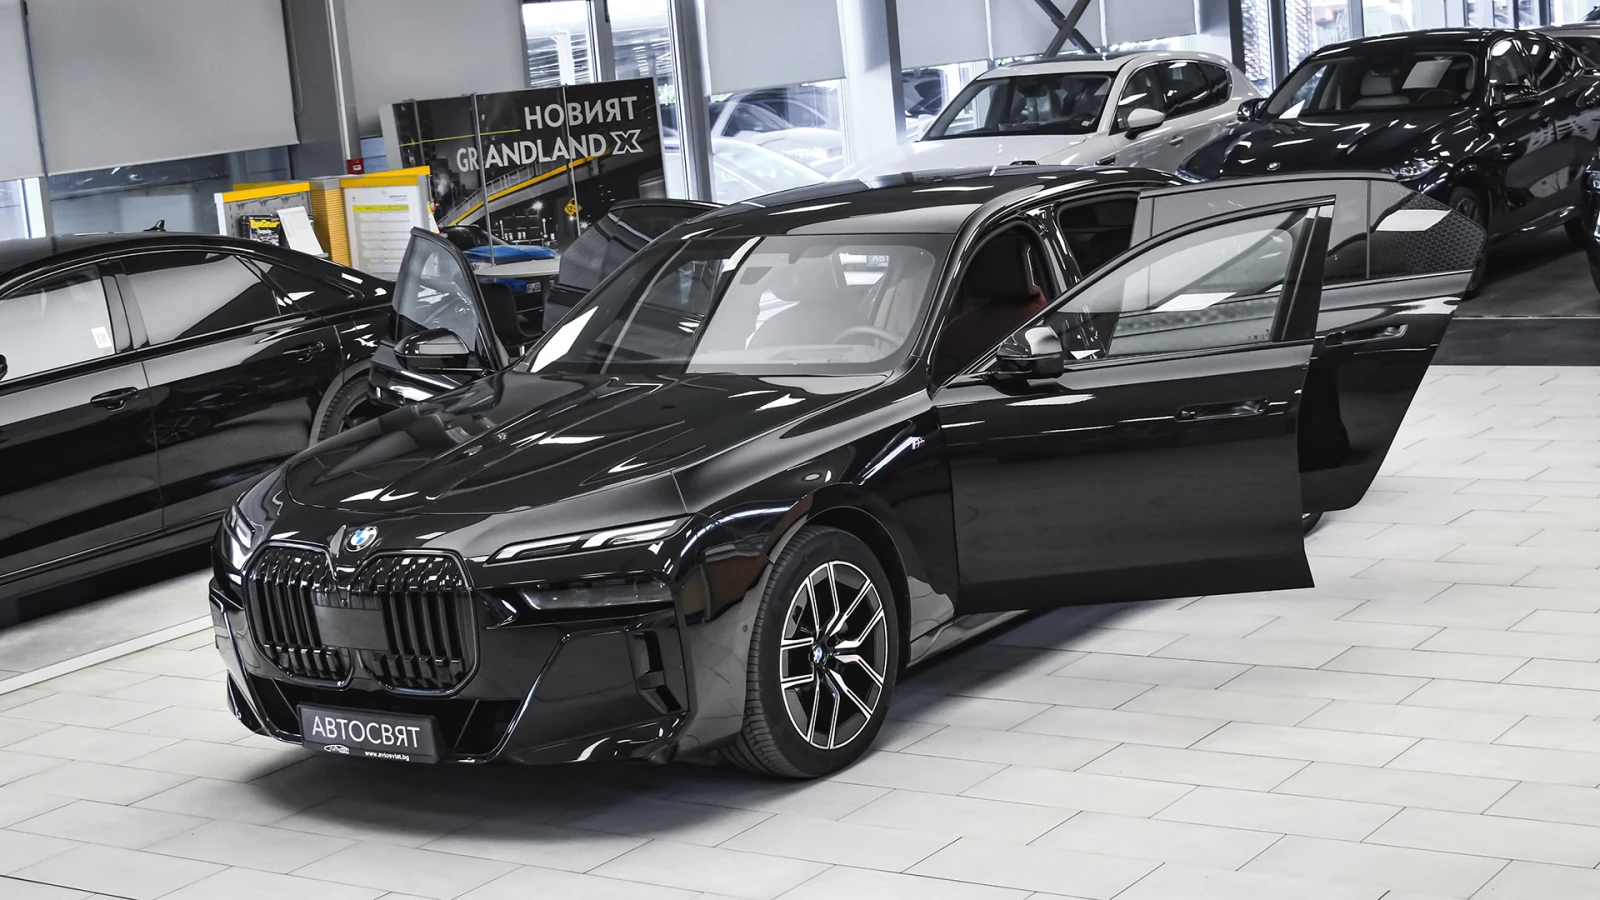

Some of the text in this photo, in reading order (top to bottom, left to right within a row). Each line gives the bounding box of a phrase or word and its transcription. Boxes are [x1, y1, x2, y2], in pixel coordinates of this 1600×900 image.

[524, 96, 638, 131] НОВИЯТ
[456, 129, 644, 173] GRANDLAND X
[312, 715, 420, 748] АВТОСВЯТ
[364, 750, 410, 762] www.avtosviat.bg
